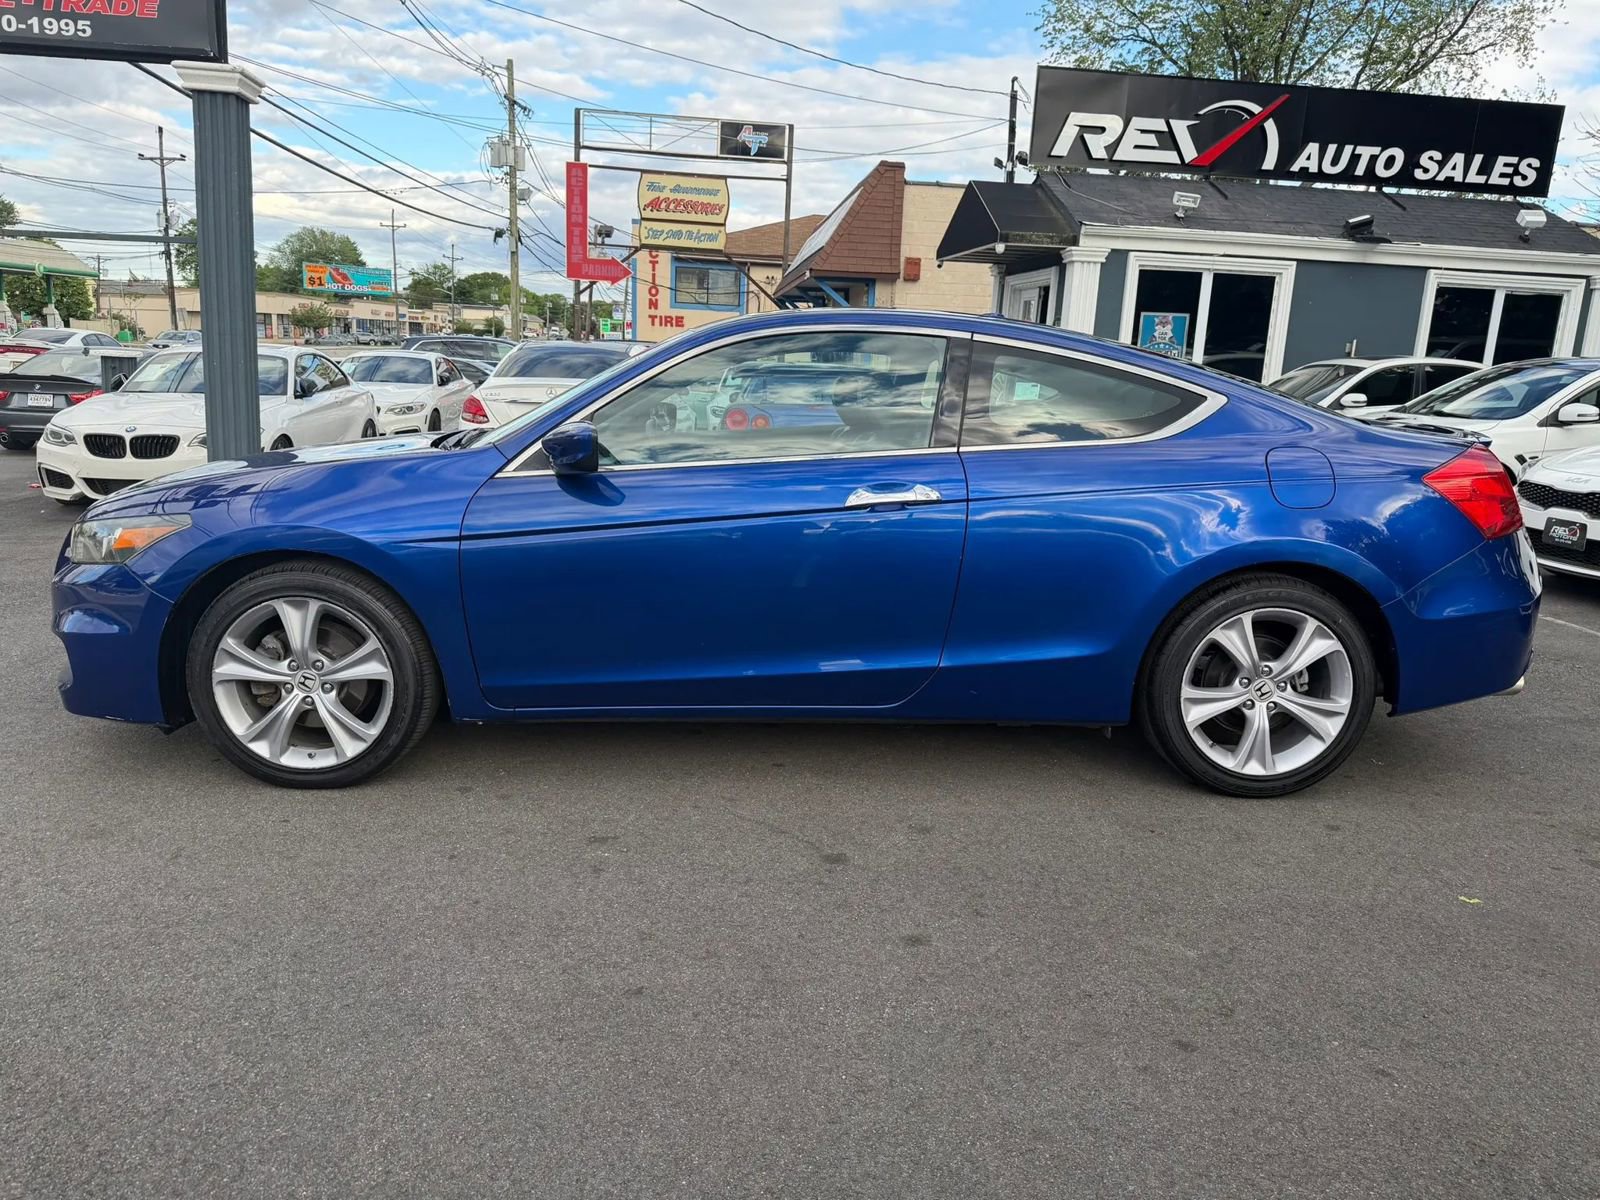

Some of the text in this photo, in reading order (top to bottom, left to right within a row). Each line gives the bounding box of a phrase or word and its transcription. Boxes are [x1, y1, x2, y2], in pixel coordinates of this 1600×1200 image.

[1, 14, 92, 37] 0-1995
[1289, 142, 1405, 178] AUTO
[1413, 150, 1541, 187] SALES
[643, 196, 725, 216] ACCESSORIES
[582, 263, 624, 277] PARKING
[308, 275, 324, 287] $1
[325, 283, 368, 292] HOT DOGS
[648, 314, 684, 328] TIRE
